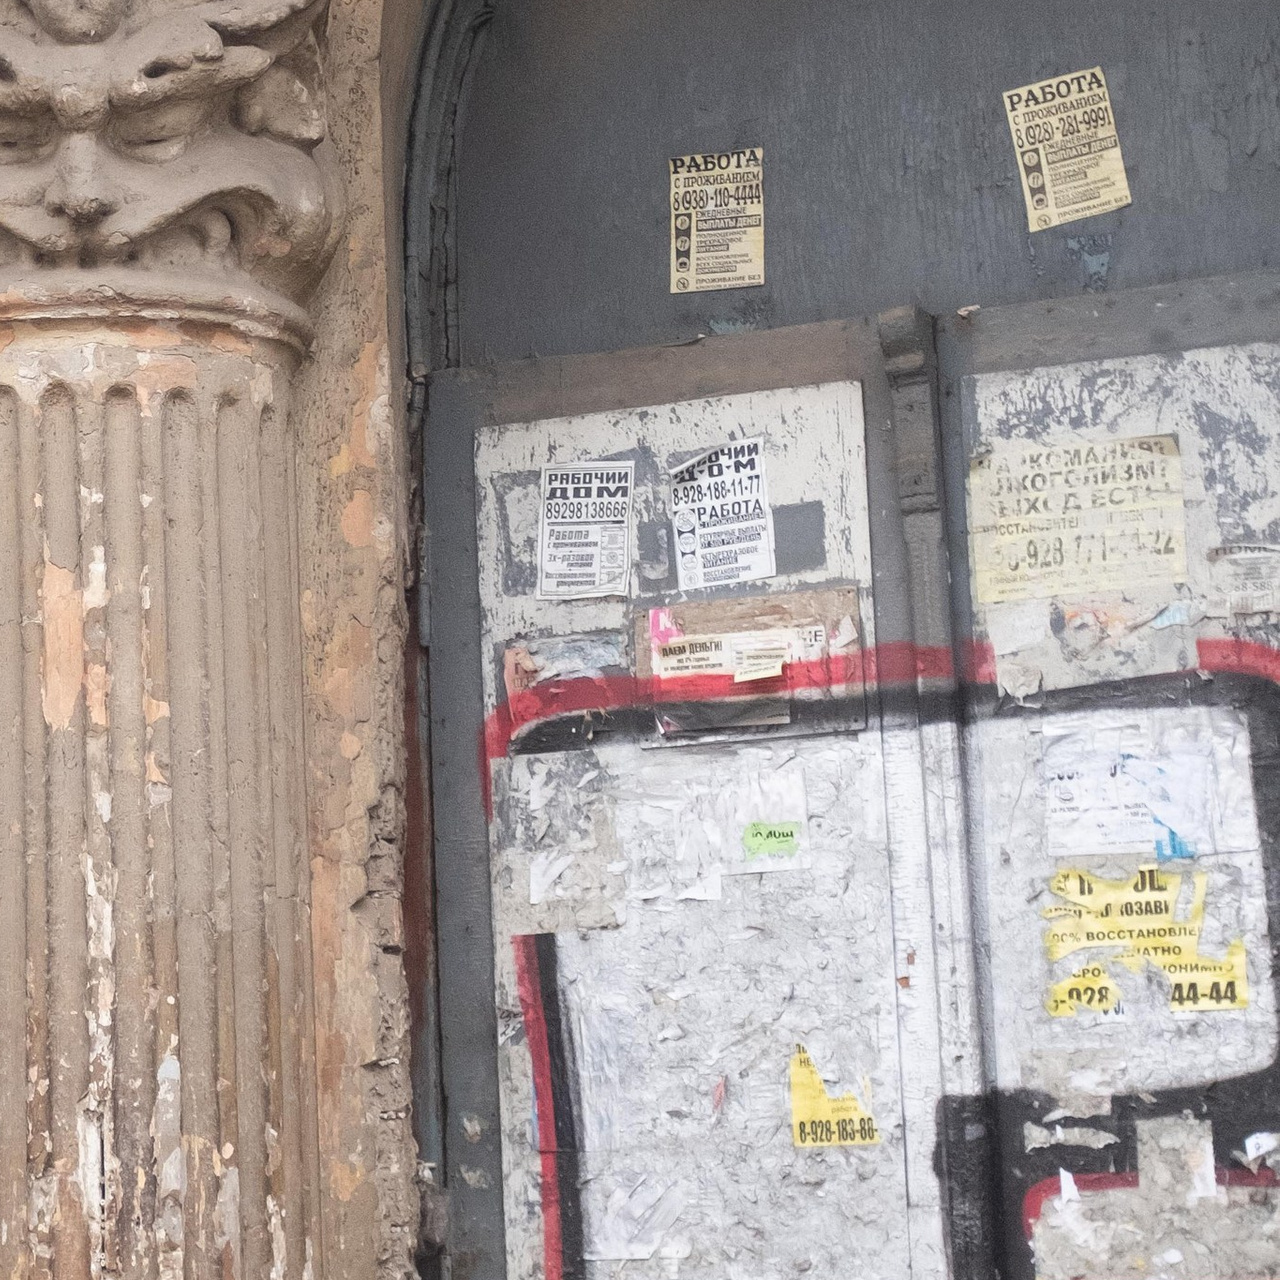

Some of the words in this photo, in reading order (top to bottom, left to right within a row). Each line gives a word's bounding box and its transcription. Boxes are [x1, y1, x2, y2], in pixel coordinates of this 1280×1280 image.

[1007, 72, 1104, 112] РАБОТА
[1013, 115, 1020, 126] С
[1022, 91, 1108, 124] ПРОЖИВАНИЕМ
[1043, 131, 1099, 151] ЕЖЕДНЕВНЫЕ
[1047, 145, 1090, 164] ВЫПЛАТЫ
[1090, 138, 1117, 154] ДЕНЕГ
[670, 150, 760, 174] РАБОТА
[674, 178, 680, 189] С
[683, 171, 760, 188] ПРОЖИВАНИЕМ
[695, 207, 747, 219] ЕЖЕДНЕВНЫЕ
[697, 217, 737, 231] ВЫПЛАТЫ
[737, 216, 760, 228] ДЕНЕГ
[546, 486, 629, 500] ДОМ
[546, 501, 627, 519] 89298138666
[697, 499, 763, 520] РАБОТА
[548, 529, 589, 540] Работа
[662, 644, 687, 658] ДАЕМ
[688, 640, 723, 655] ДЕНЬГИ!
[1086, 926, 1201, 941] ВОССТАНОВЛЕ
